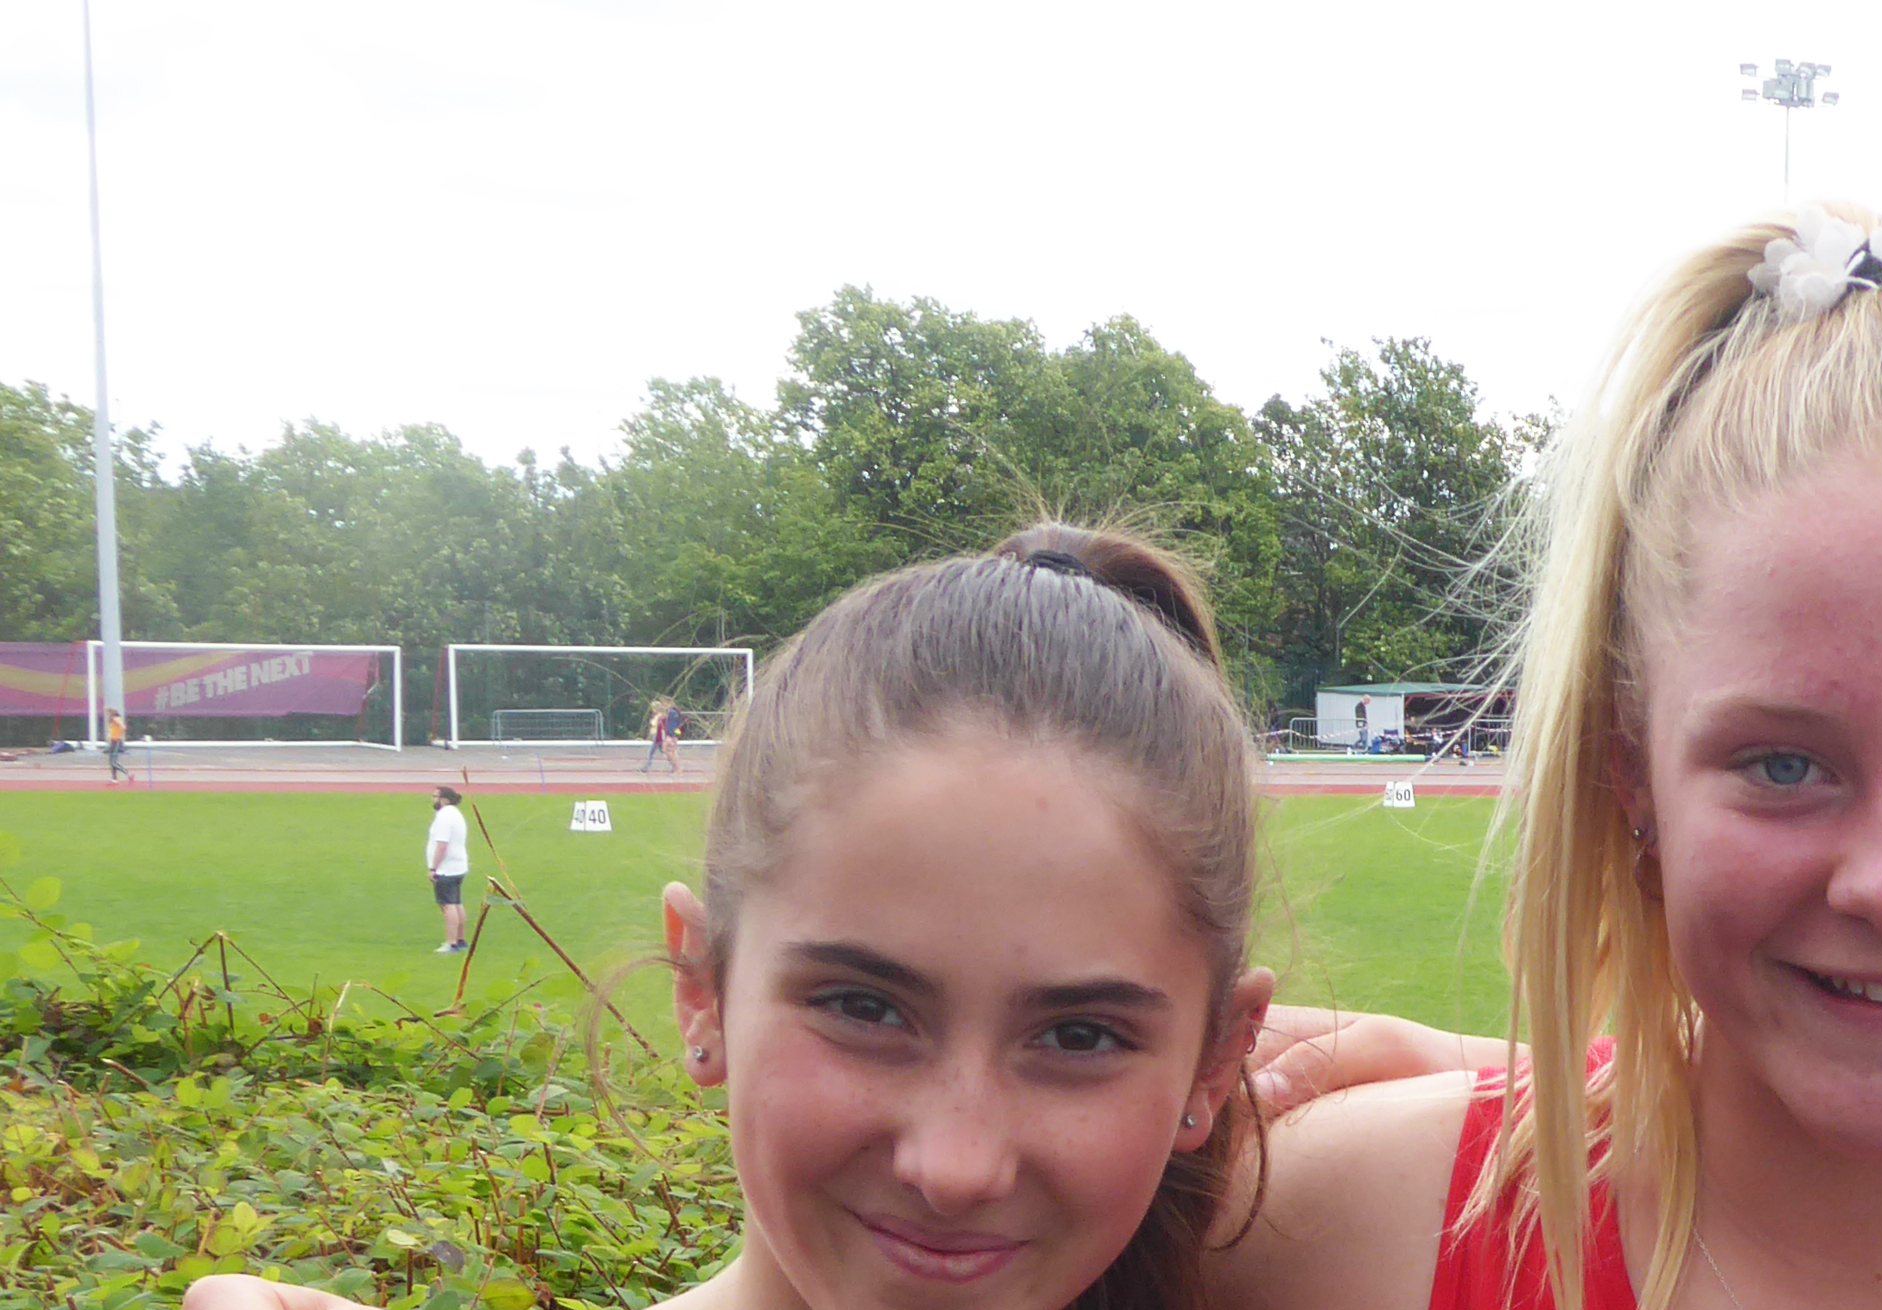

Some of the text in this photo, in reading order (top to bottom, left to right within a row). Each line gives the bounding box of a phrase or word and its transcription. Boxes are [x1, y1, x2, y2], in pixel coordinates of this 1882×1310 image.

[155, 651, 314, 712] #BE THE NEXT
[1395, 789, 1411, 801] 60
[588, 809, 606, 824] 40
